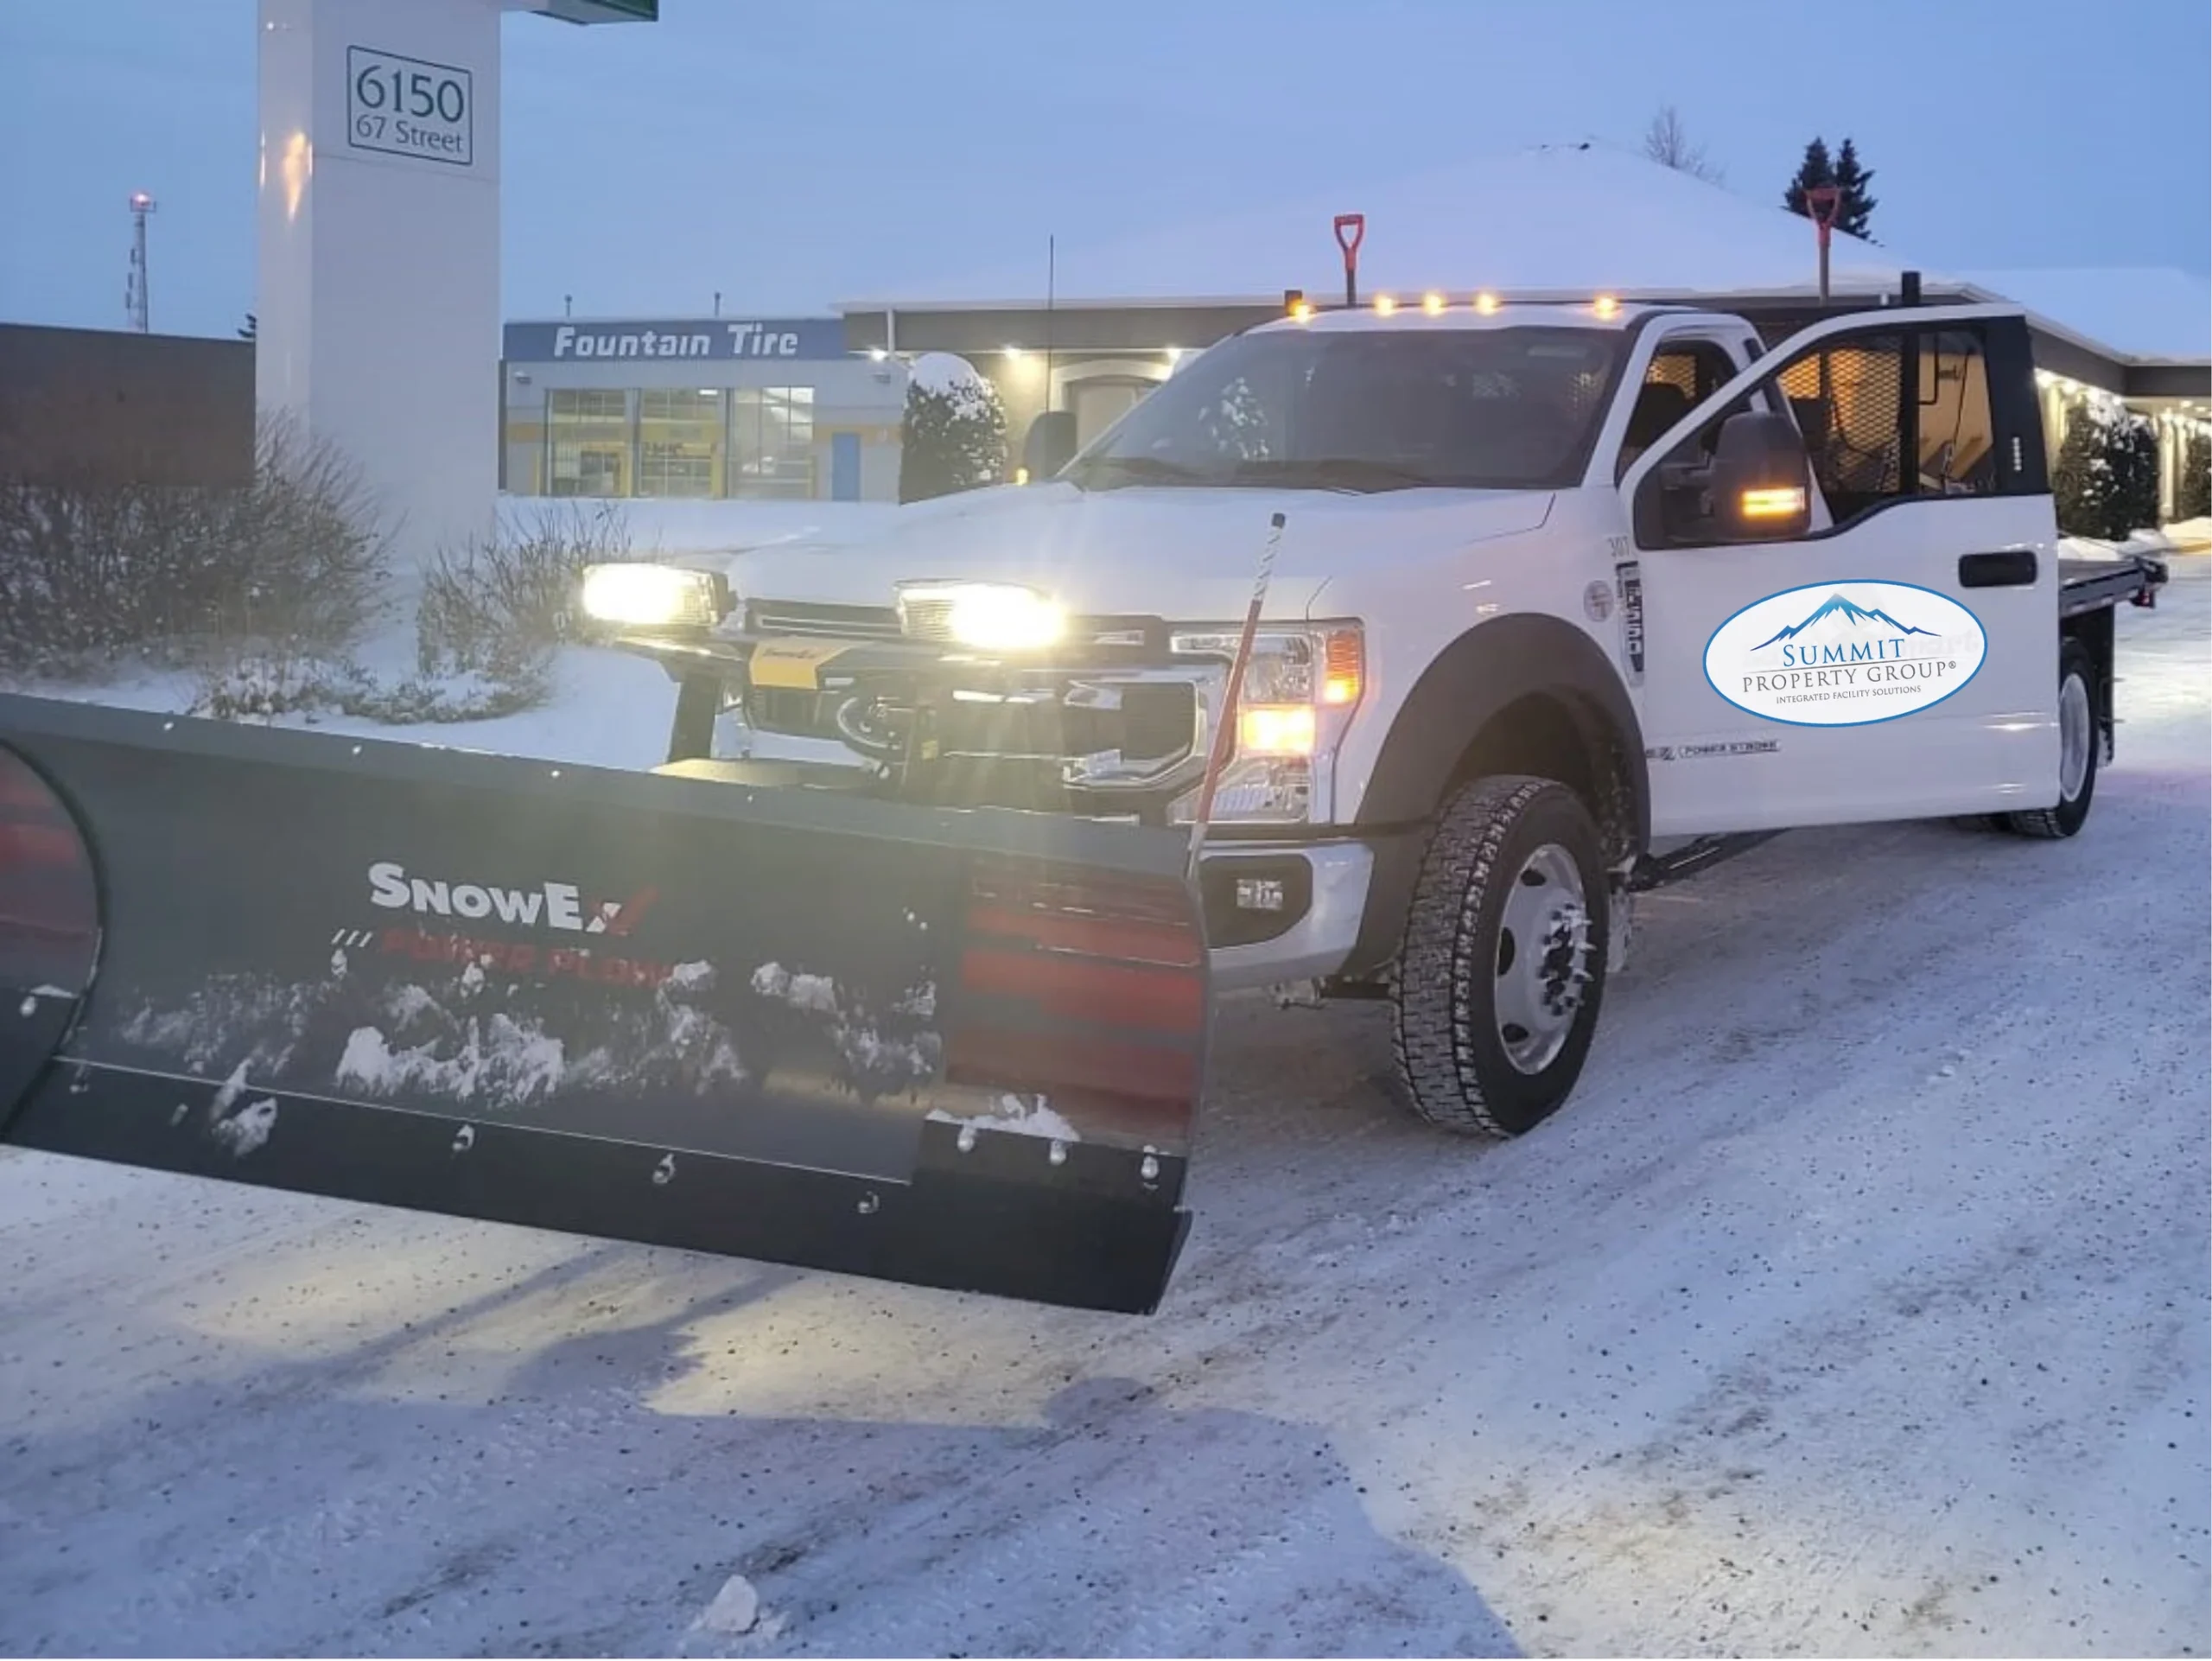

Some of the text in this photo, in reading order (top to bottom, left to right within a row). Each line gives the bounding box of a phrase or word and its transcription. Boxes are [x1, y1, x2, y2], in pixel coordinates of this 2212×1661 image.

[356, 65, 464, 123] 6150
[356, 114, 463, 153] 67 Street
[554, 323, 798, 358] Fountain Tire
[1783, 638, 1905, 668] SUMMIT
[1742, 668, 1858, 693] PROPERTY
[1776, 684, 1922, 704] INTEGRATED FACILITY SOLUTIONS
